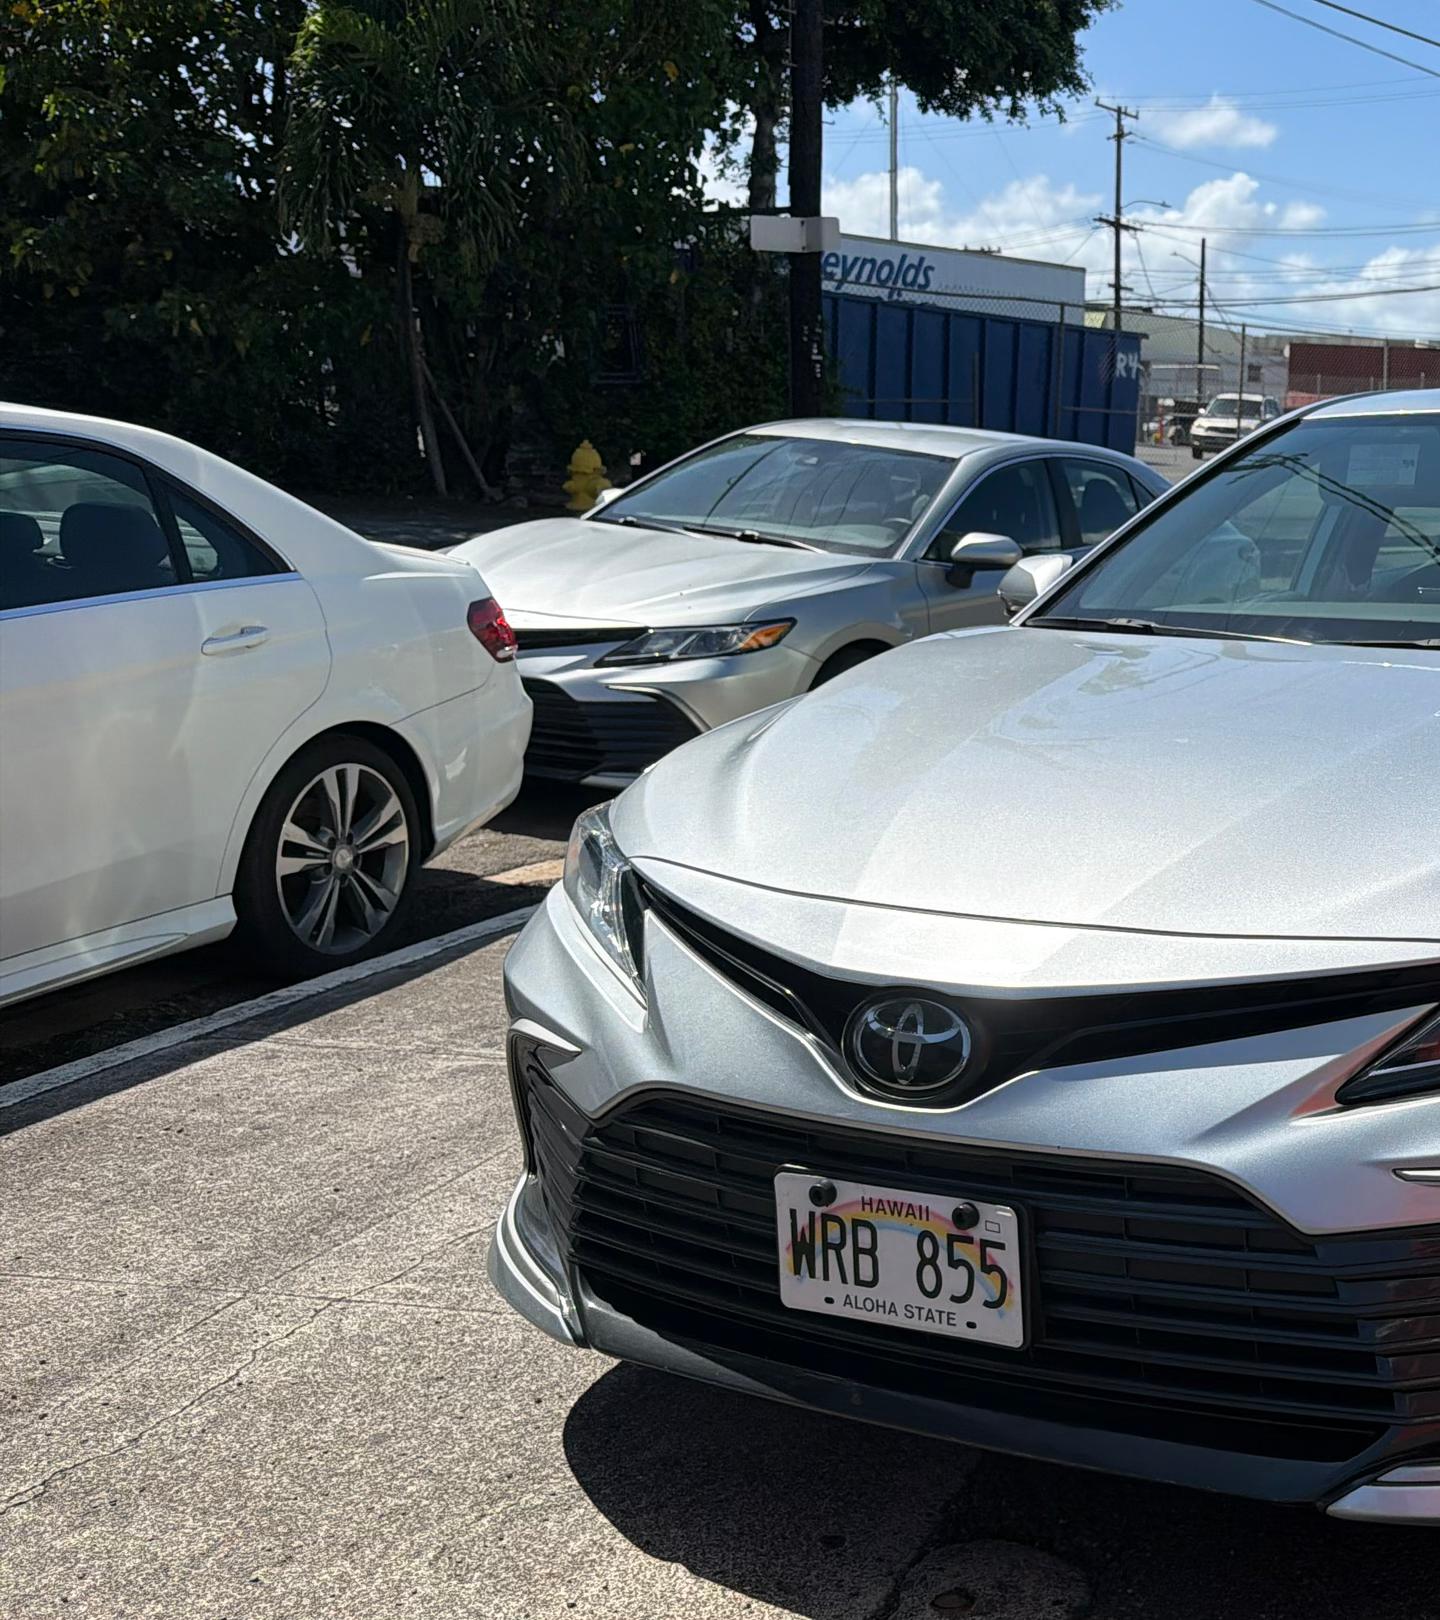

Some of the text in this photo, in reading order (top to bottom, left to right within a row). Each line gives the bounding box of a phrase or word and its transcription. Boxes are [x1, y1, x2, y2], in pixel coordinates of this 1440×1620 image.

[822, 251, 935, 290] eynolds
[861, 1196, 930, 1222] HAWAII
[789, 1208, 1008, 1309] WRB 855
[843, 1294, 957, 1327] ALOHA STATE
